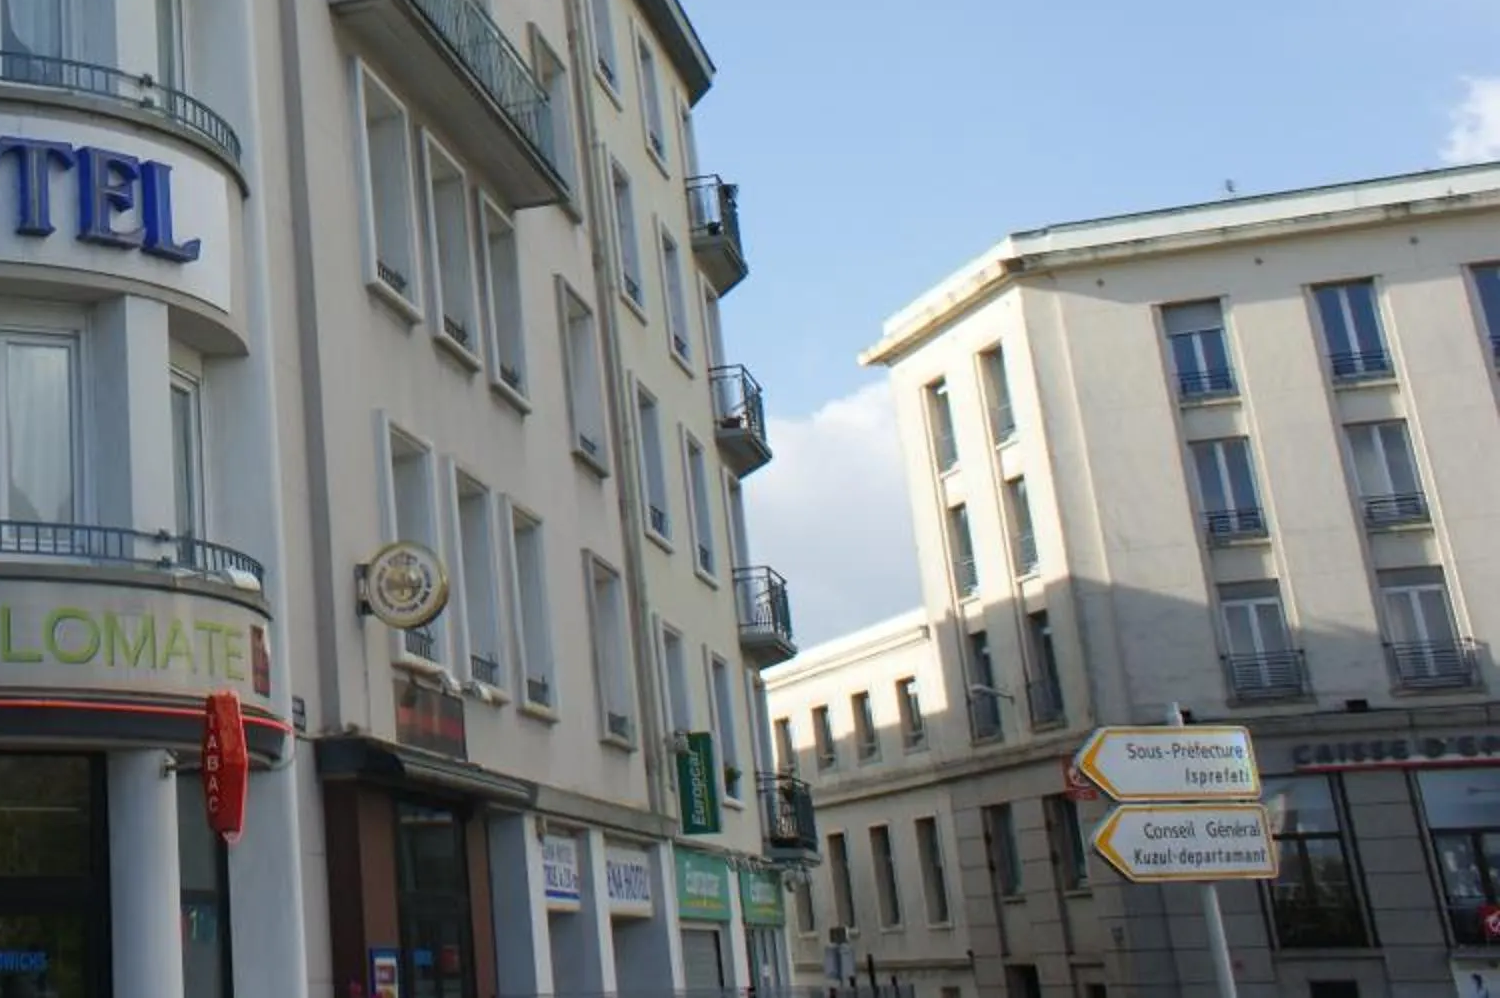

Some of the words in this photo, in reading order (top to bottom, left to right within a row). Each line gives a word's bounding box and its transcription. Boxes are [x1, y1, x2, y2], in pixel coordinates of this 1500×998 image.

[206, 713, 220, 812] TABAC
[1293, 738, 1409, 764] CAISSE
[688, 750, 706, 826] Europcar
[1185, 767, 1250, 785] Isprefeti
[1143, 821, 1196, 840] Conseil
[1205, 819, 1262, 839] Général
